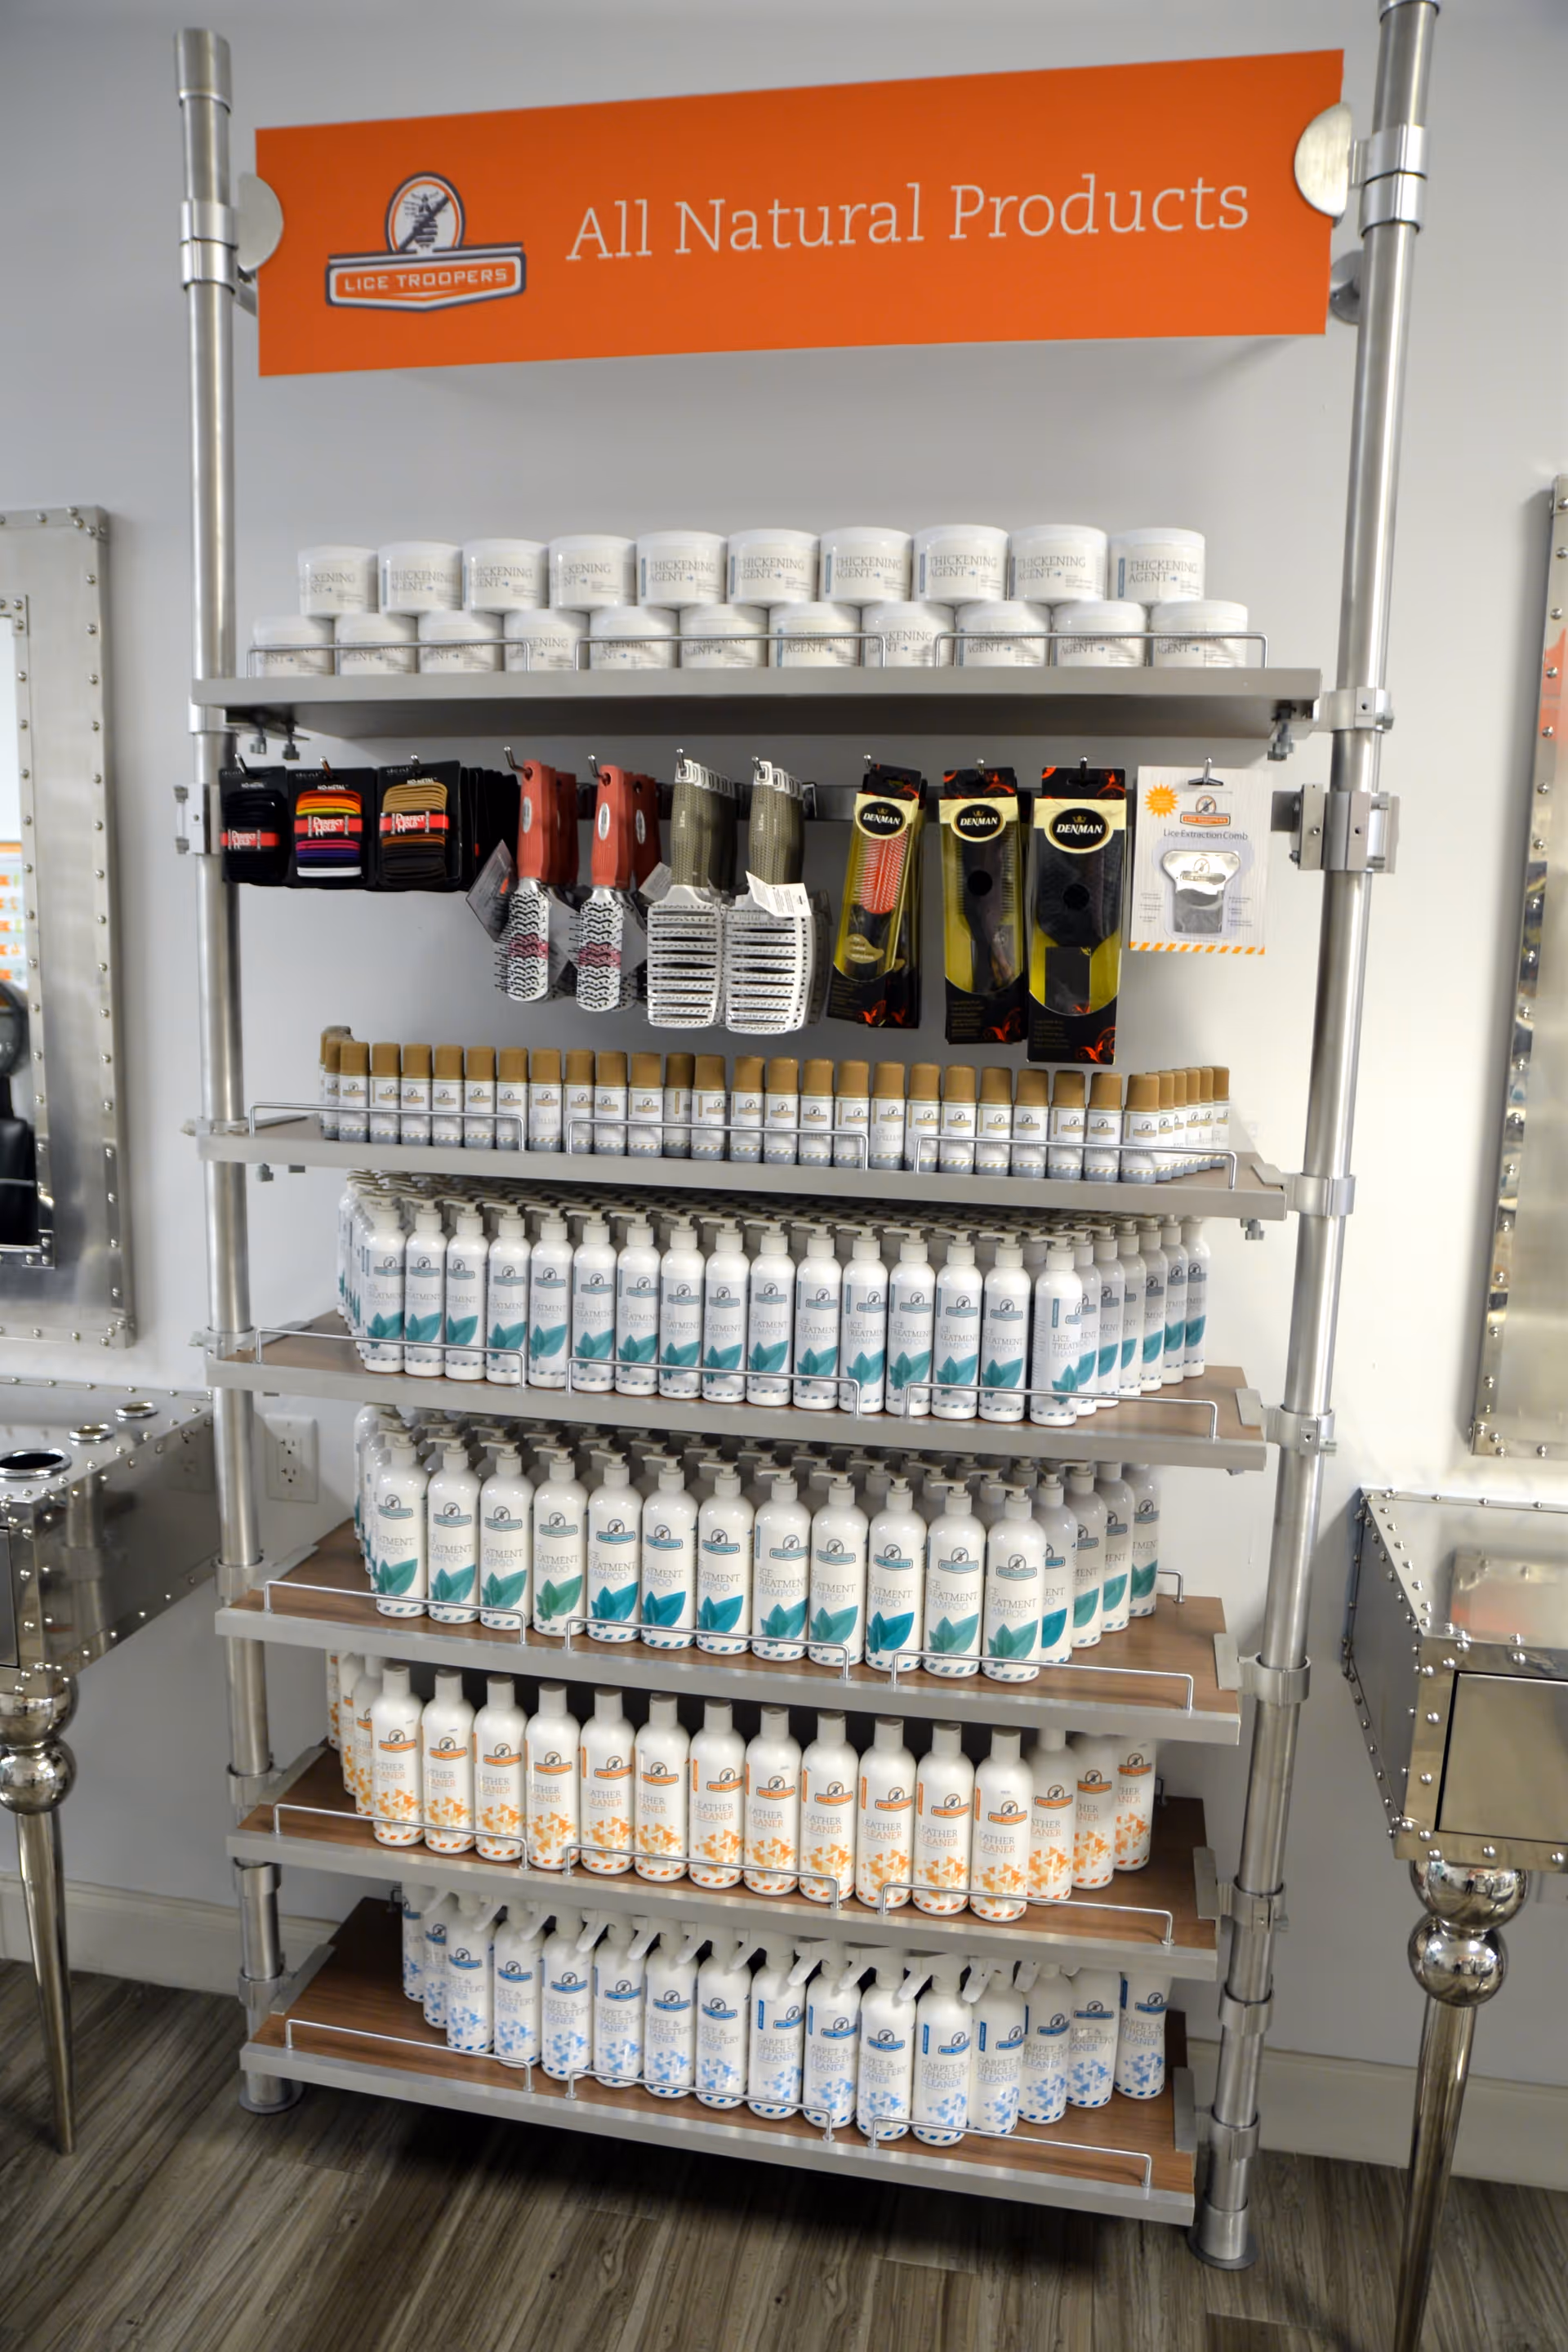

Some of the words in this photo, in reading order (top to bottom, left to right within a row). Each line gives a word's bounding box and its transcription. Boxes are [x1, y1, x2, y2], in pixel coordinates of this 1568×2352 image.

[566, 198, 652, 261] All
[674, 182, 924, 254] Natural
[949, 173, 1249, 240] Products
[344, 274, 389, 292] LICE
[396, 268, 508, 288] TROOPERS
[862, 812, 901, 826] DENMAN
[960, 817, 998, 827] DENMAN
[1056, 823, 1102, 835] DENMAN
[1164, 829, 1179, 837] Lice
[1181, 830, 1223, 839] Extraction
[1223, 831, 1248, 840] Comb
